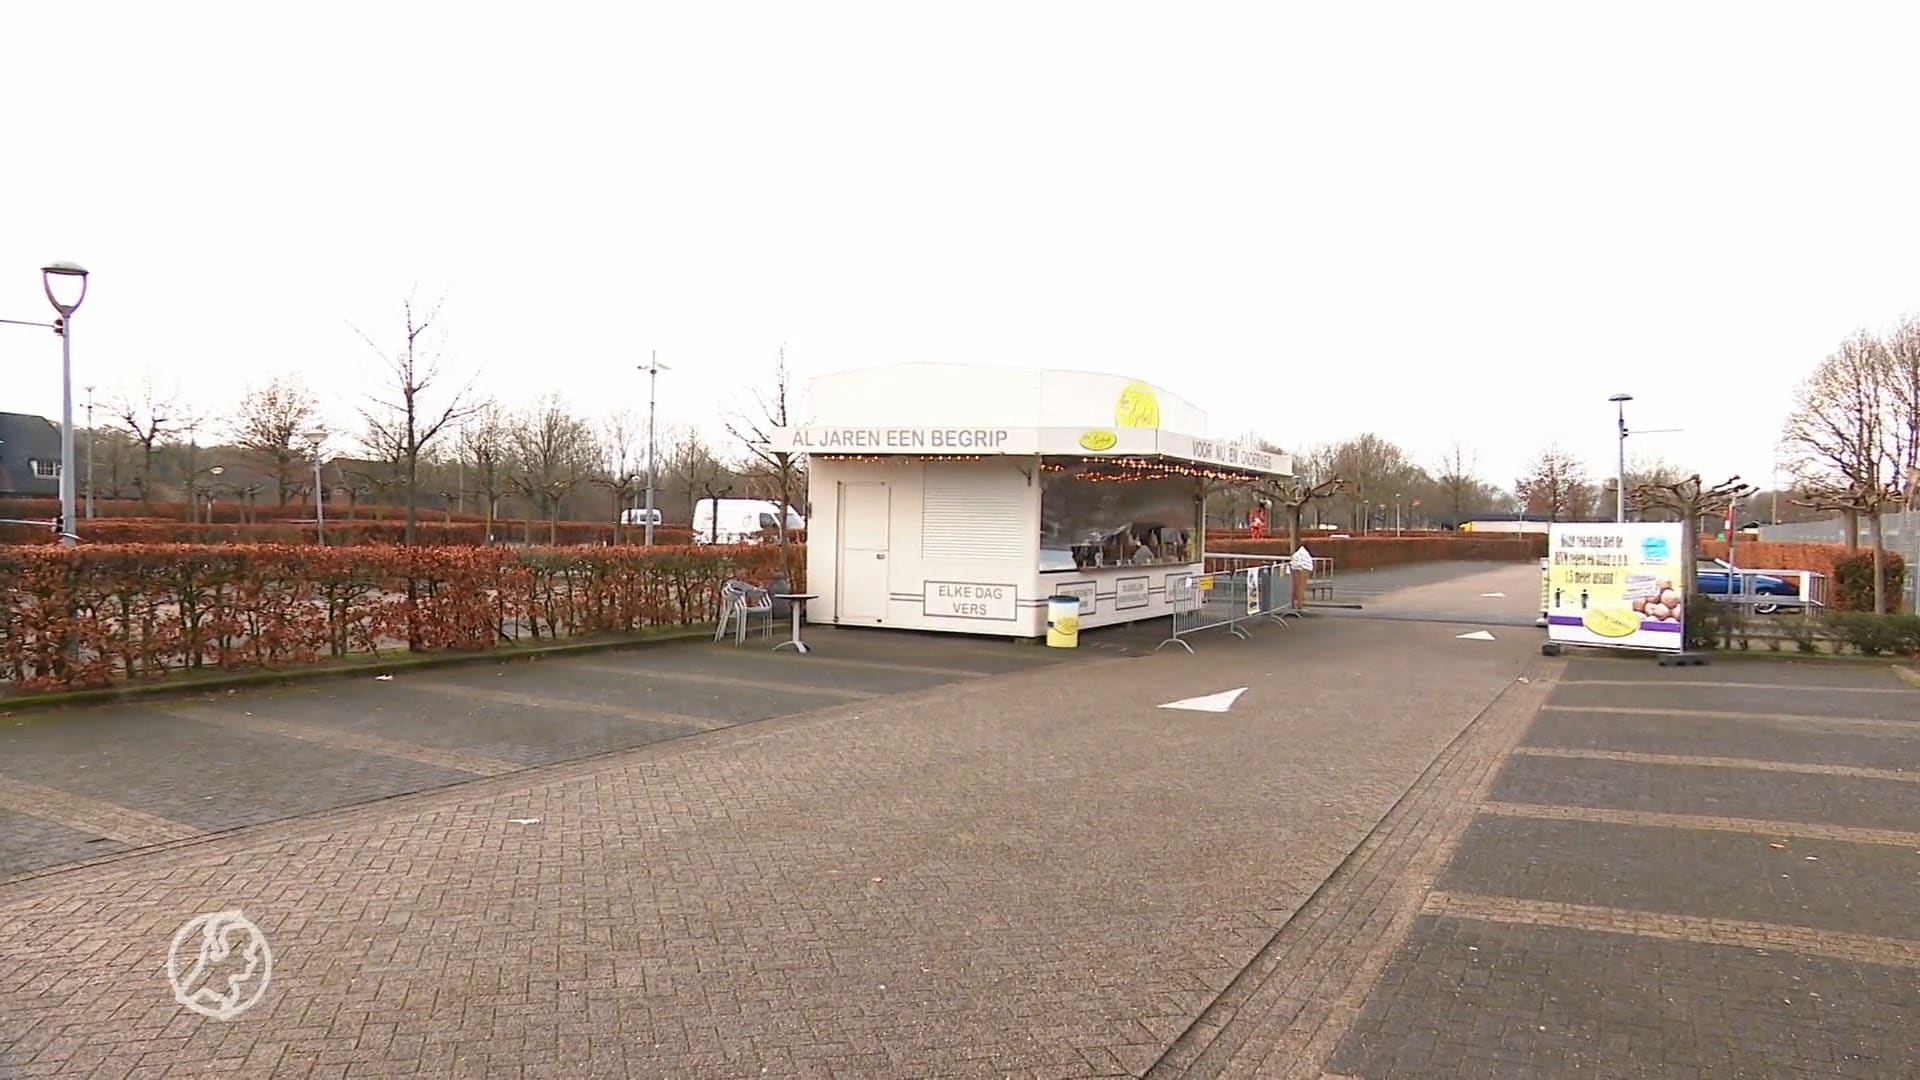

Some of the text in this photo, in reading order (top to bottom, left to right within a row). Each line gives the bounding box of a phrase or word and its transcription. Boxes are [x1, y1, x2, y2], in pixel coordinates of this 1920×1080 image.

[792, 430, 1008, 448] AL JAREN EEN BEGRIP
[1192, 439, 1212, 458] VOOR
[1229, 447, 1238, 463] EN
[938, 585, 1003, 600] ELKE DAG
[952, 602, 988, 616] VERS
